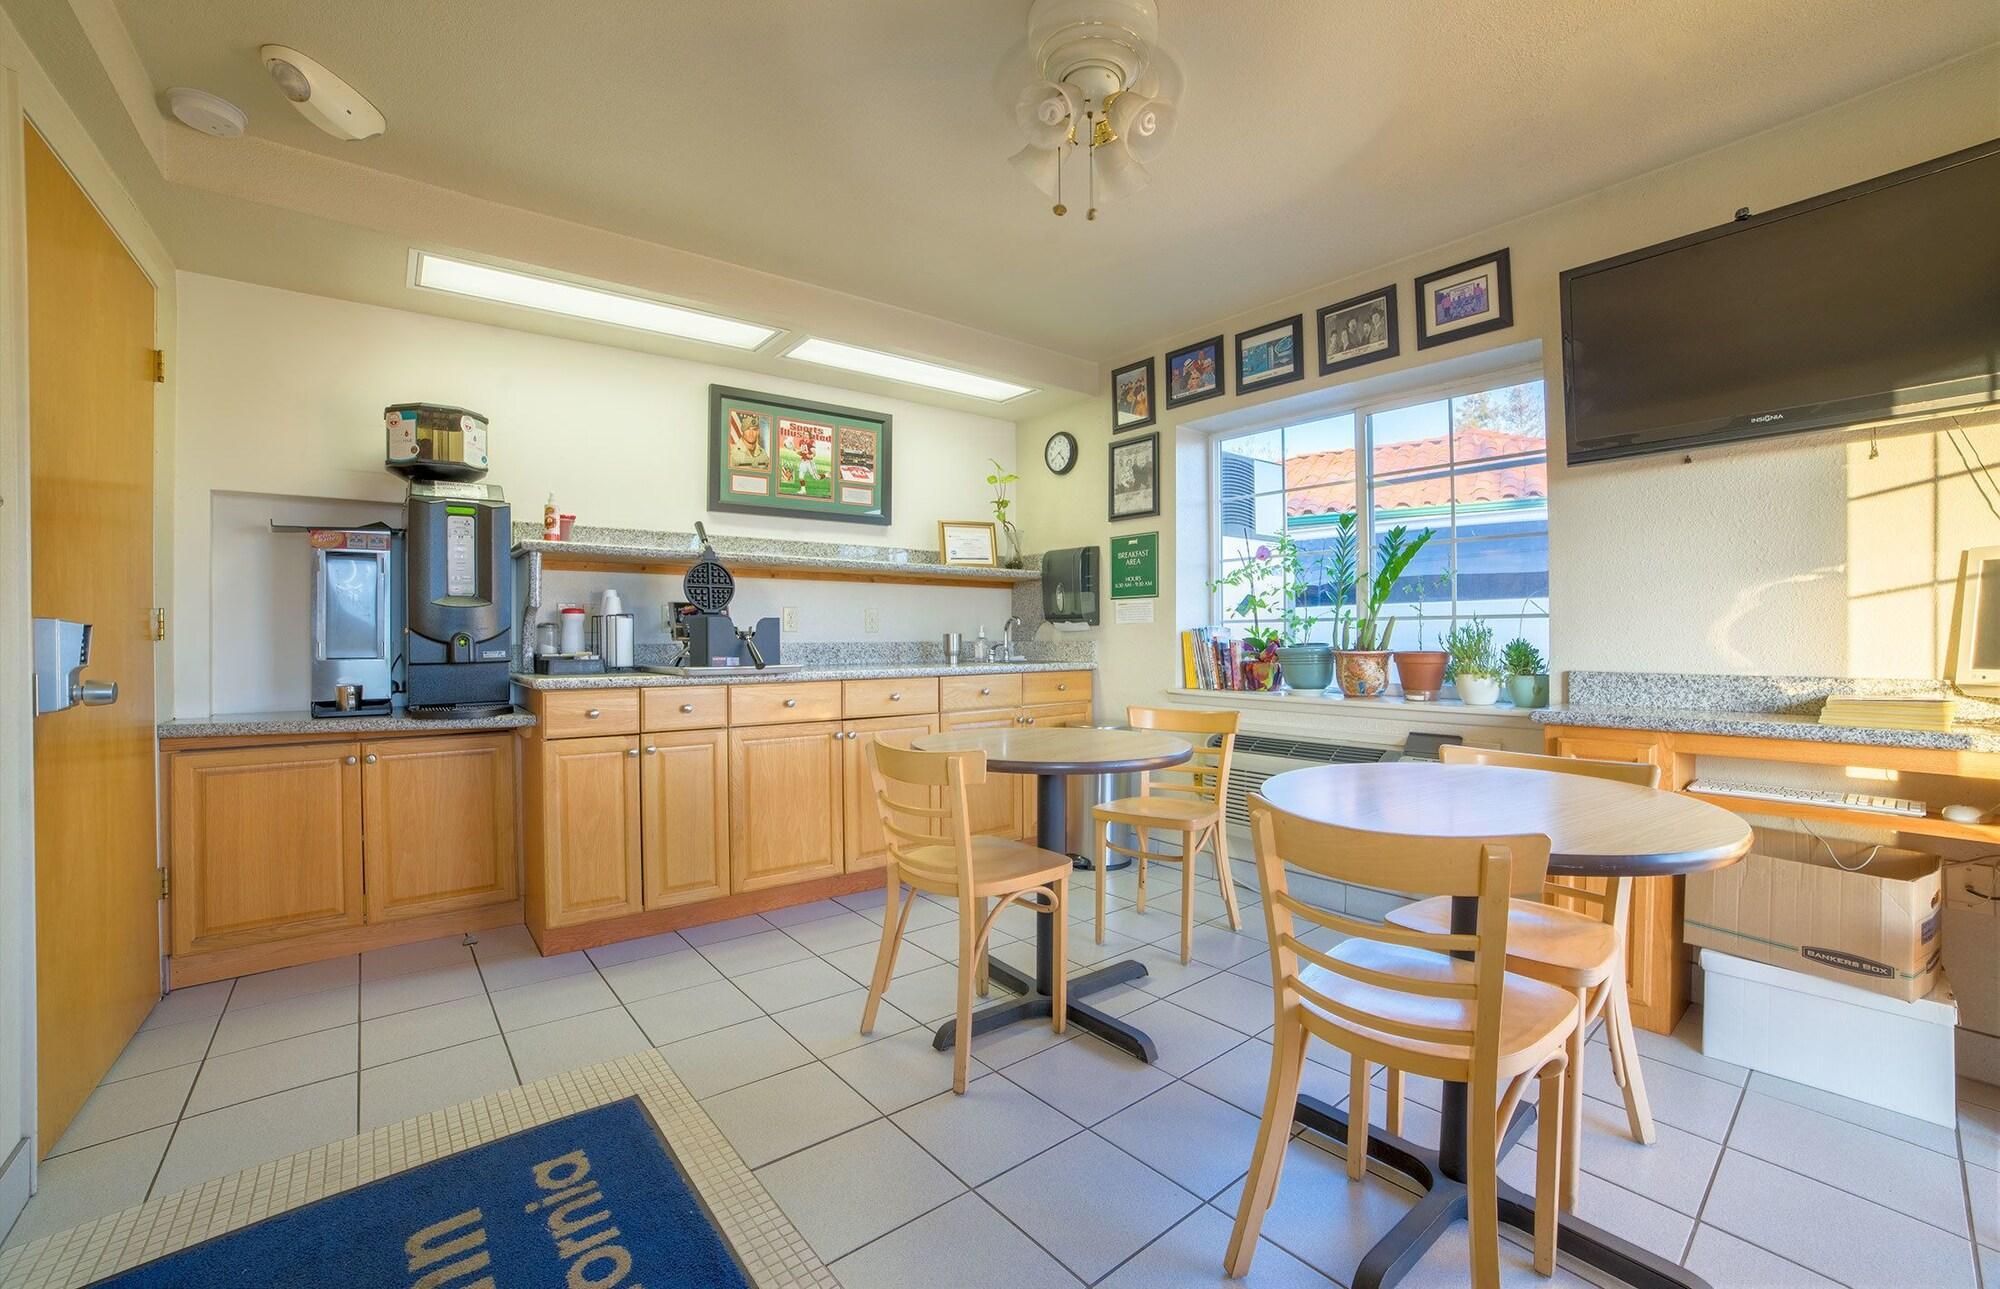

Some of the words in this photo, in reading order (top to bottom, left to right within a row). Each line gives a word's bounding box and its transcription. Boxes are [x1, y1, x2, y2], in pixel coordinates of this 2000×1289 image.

[789, 423, 824, 435] Sports
[1117, 549, 1149, 559] BREAKFAST
[1806, 949, 1860, 968] BANKERS
[1862, 963, 1889, 975] BOX
[525, 1149, 643, 1289] ornia
